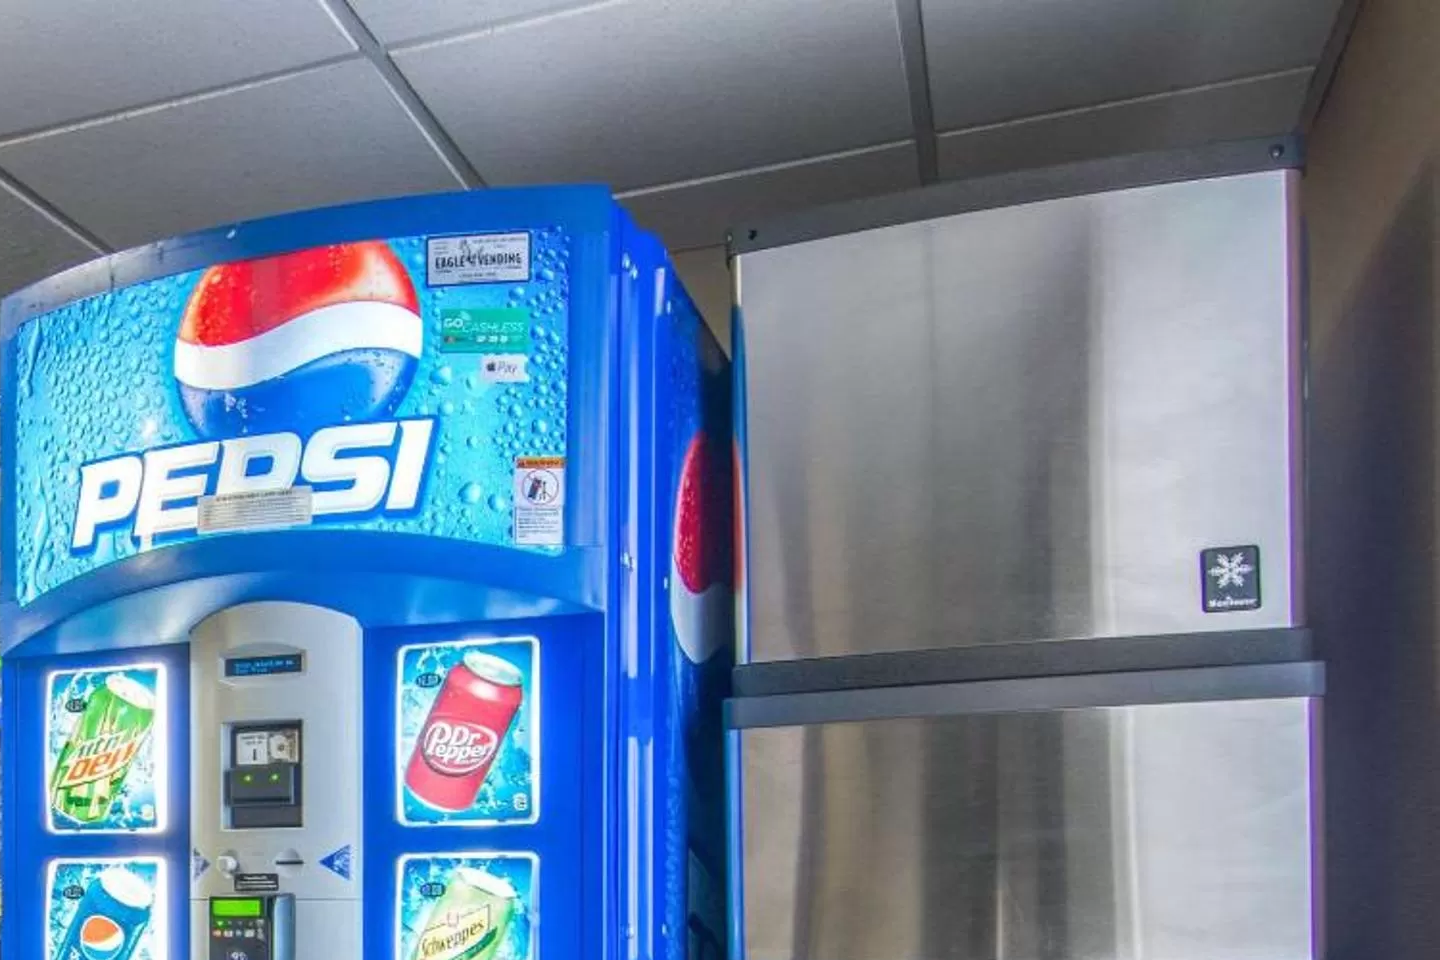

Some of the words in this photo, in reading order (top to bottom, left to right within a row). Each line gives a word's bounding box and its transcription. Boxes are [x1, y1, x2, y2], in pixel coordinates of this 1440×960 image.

[72, 419, 435, 549] PEPSI
[425, 720, 491, 764] Pepper
[451, 724, 481, 747] Dr
